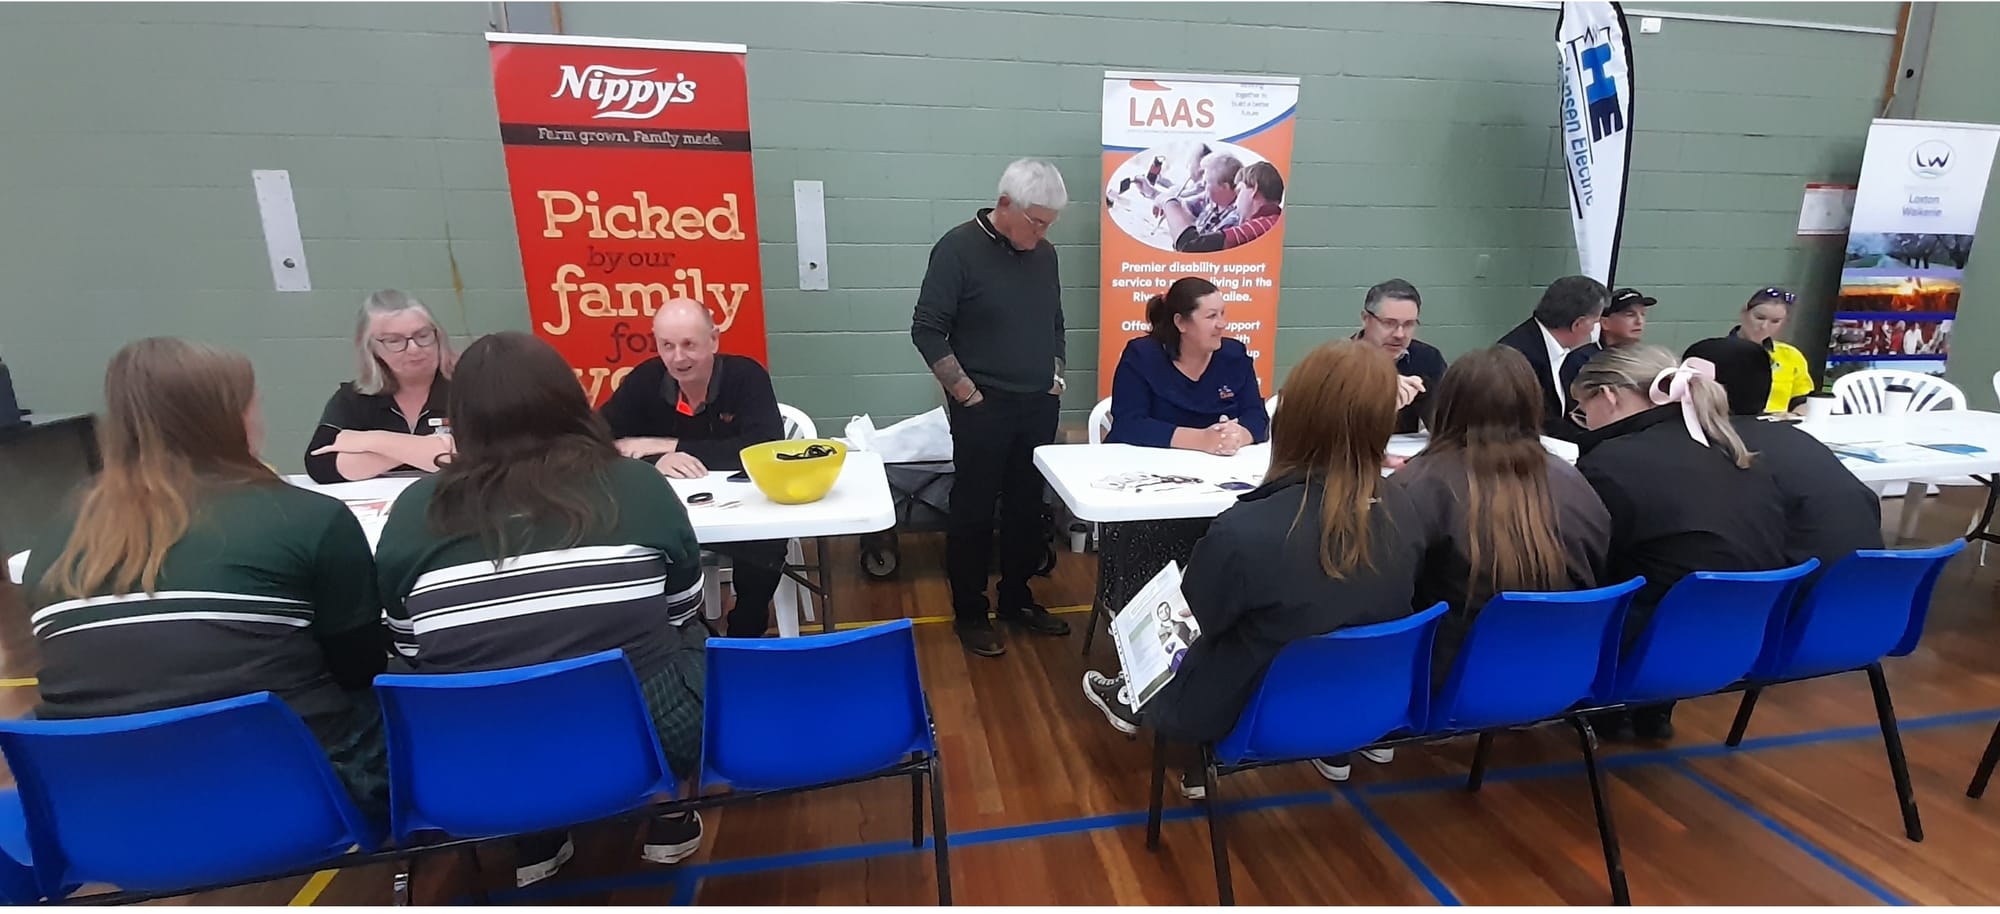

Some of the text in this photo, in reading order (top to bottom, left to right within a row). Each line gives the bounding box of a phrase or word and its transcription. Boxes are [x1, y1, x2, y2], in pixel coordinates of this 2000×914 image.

[551, 65, 697, 119] Nippy's
[1129, 97, 1215, 128] LAAS
[538, 127, 723, 147] Farm grown. Family made.
[537, 190, 745, 240] Picked
[587, 246, 676, 274] by our
[1121, 262, 1266, 274] Premier disability support
[1112, 277, 1152, 287] service
[1155, 277, 1166, 287] to
[1242, 277, 1252, 287] in
[1255, 277, 1272, 287] the
[1220, 291, 1252, 302] allee.
